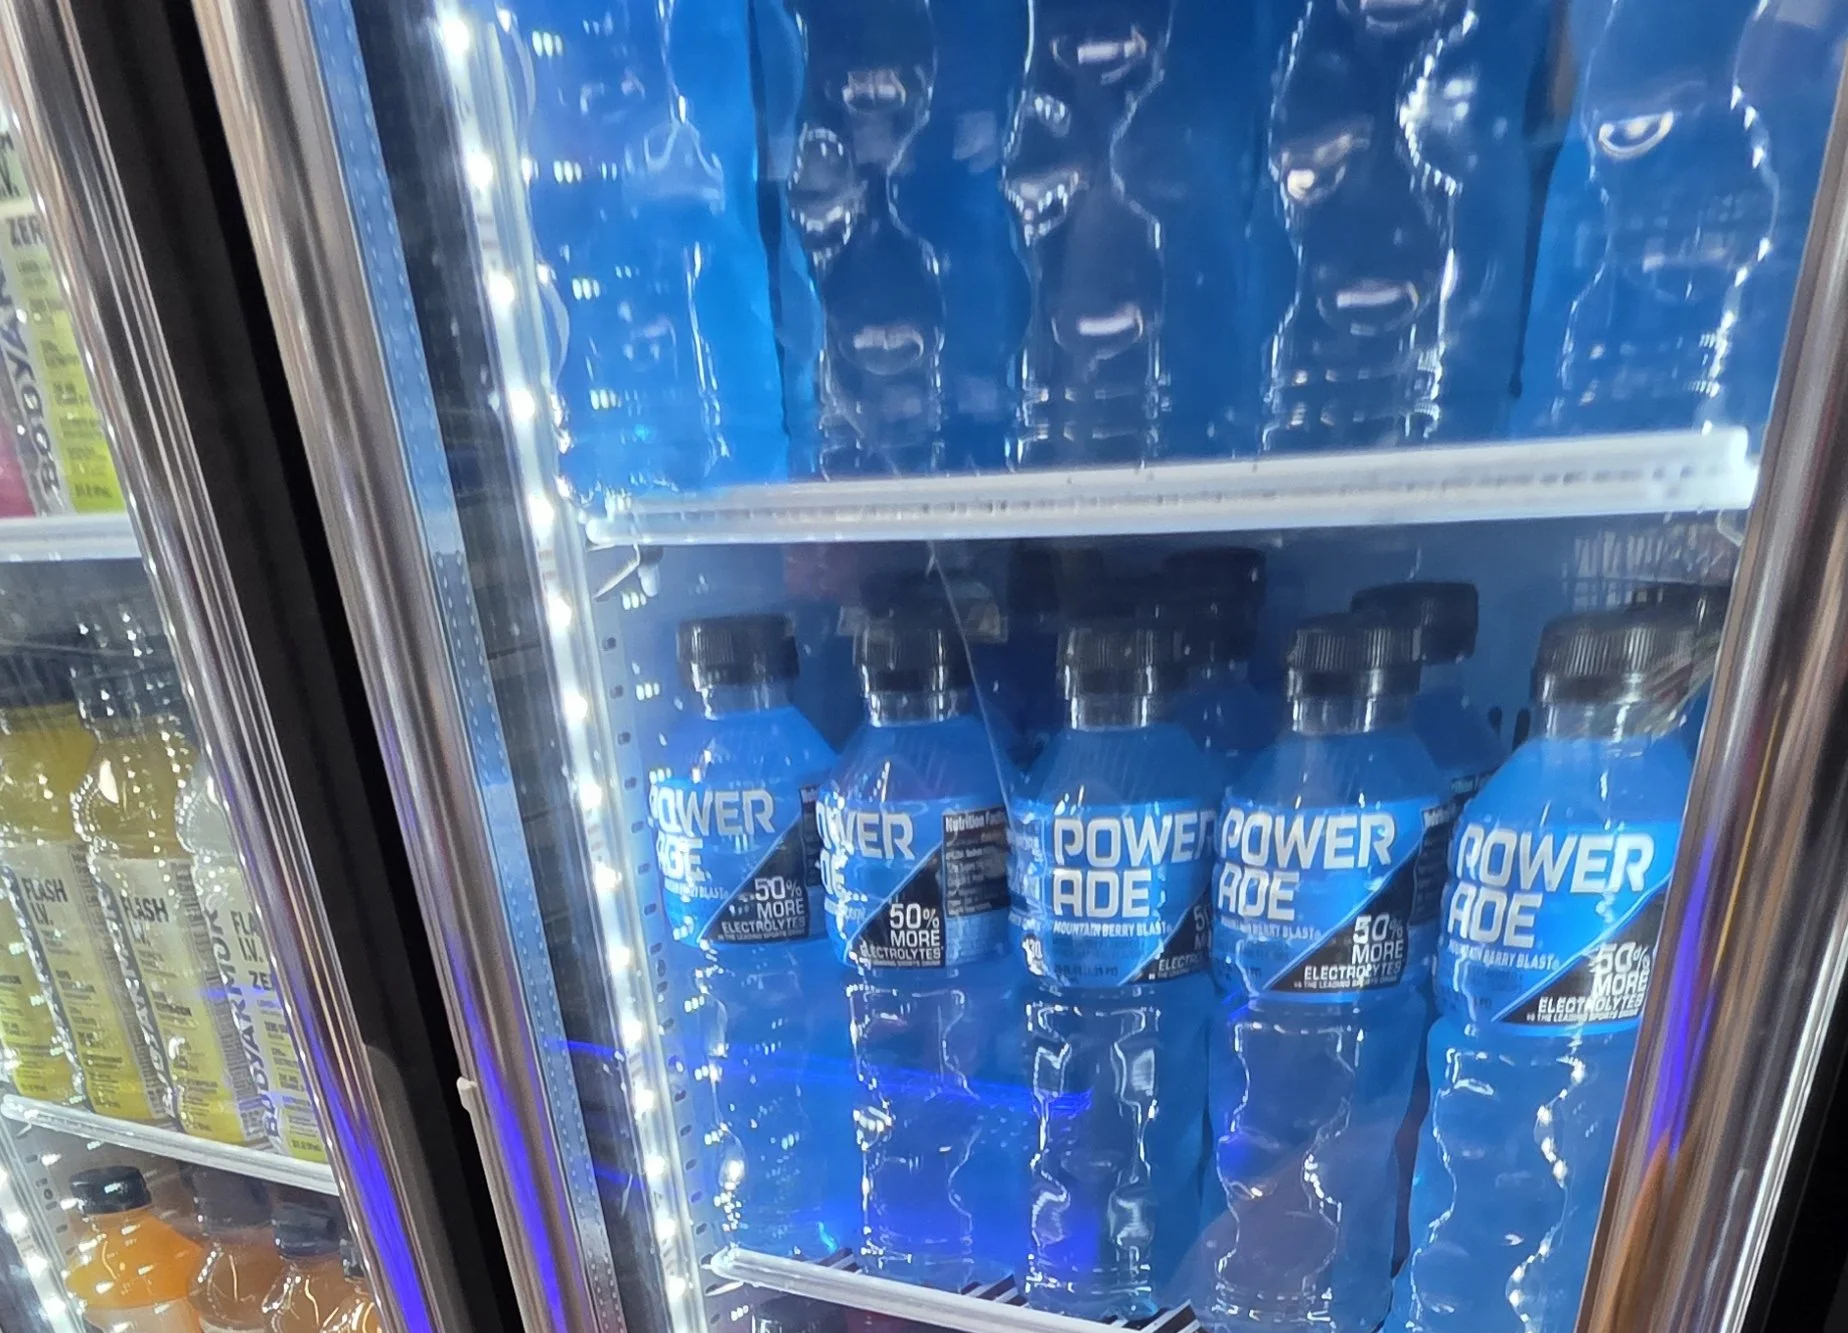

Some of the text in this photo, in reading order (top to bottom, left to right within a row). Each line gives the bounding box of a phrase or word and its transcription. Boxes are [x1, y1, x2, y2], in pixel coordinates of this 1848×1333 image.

[1221, 807, 1396, 870] POWER
[1456, 823, 1655, 894] POWER
[22, 877, 68, 903] FLASH
[755, 876, 802, 902] 50%
[1053, 867, 1152, 918] ADE
[1217, 861, 1301, 921] ADE
[757, 899, 805, 920] MORE
[889, 903, 940, 929] 50%
[1447, 881, 1544, 949] ADE
[890, 929, 941, 949] MORE
[1053, 921, 1167, 937] MOUNTAIN BERRY BLAST
[1353, 914, 1404, 944] 50%
[1351, 939, 1404, 965] MORE
[1516, 953, 1554, 971] BLAST
[1597, 942, 1651, 975] 50%
[1593, 973, 1649, 998] MORE
